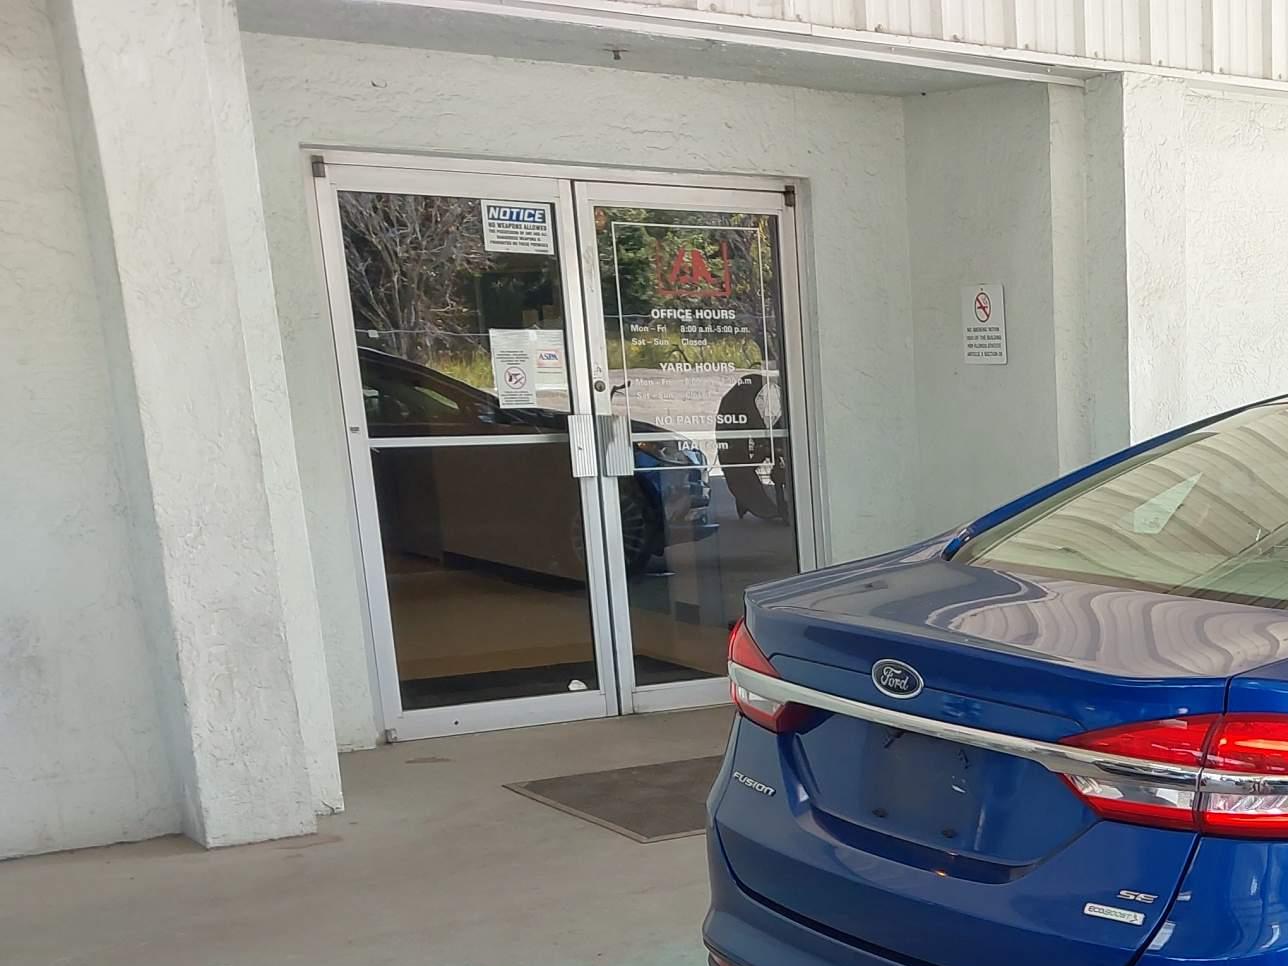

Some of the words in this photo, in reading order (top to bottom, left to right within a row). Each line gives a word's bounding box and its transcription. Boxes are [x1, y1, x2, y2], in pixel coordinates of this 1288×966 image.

[488, 206, 545, 221] NOTICE
[651, 309, 692, 320] OFFICE
[695, 309, 736, 320] HOURS
[630, 324, 648, 333] Mon
[656, 324, 667, 333] Fri
[680, 325, 697, 333] 8:00
[631, 338, 646, 346] Sat
[653, 338, 669, 346] Sun
[681, 338, 708, 346] Closed
[659, 362, 692, 372] YARD
[695, 362, 736, 372] HOURS
[655, 415, 673, 425] NO
[676, 415, 716, 425] PARTS
[717, 414, 748, 424] SOLD
[880, 666, 909, 691] Ford
[733, 771, 775, 797] FUSION
[1116, 889, 1159, 904] SE
